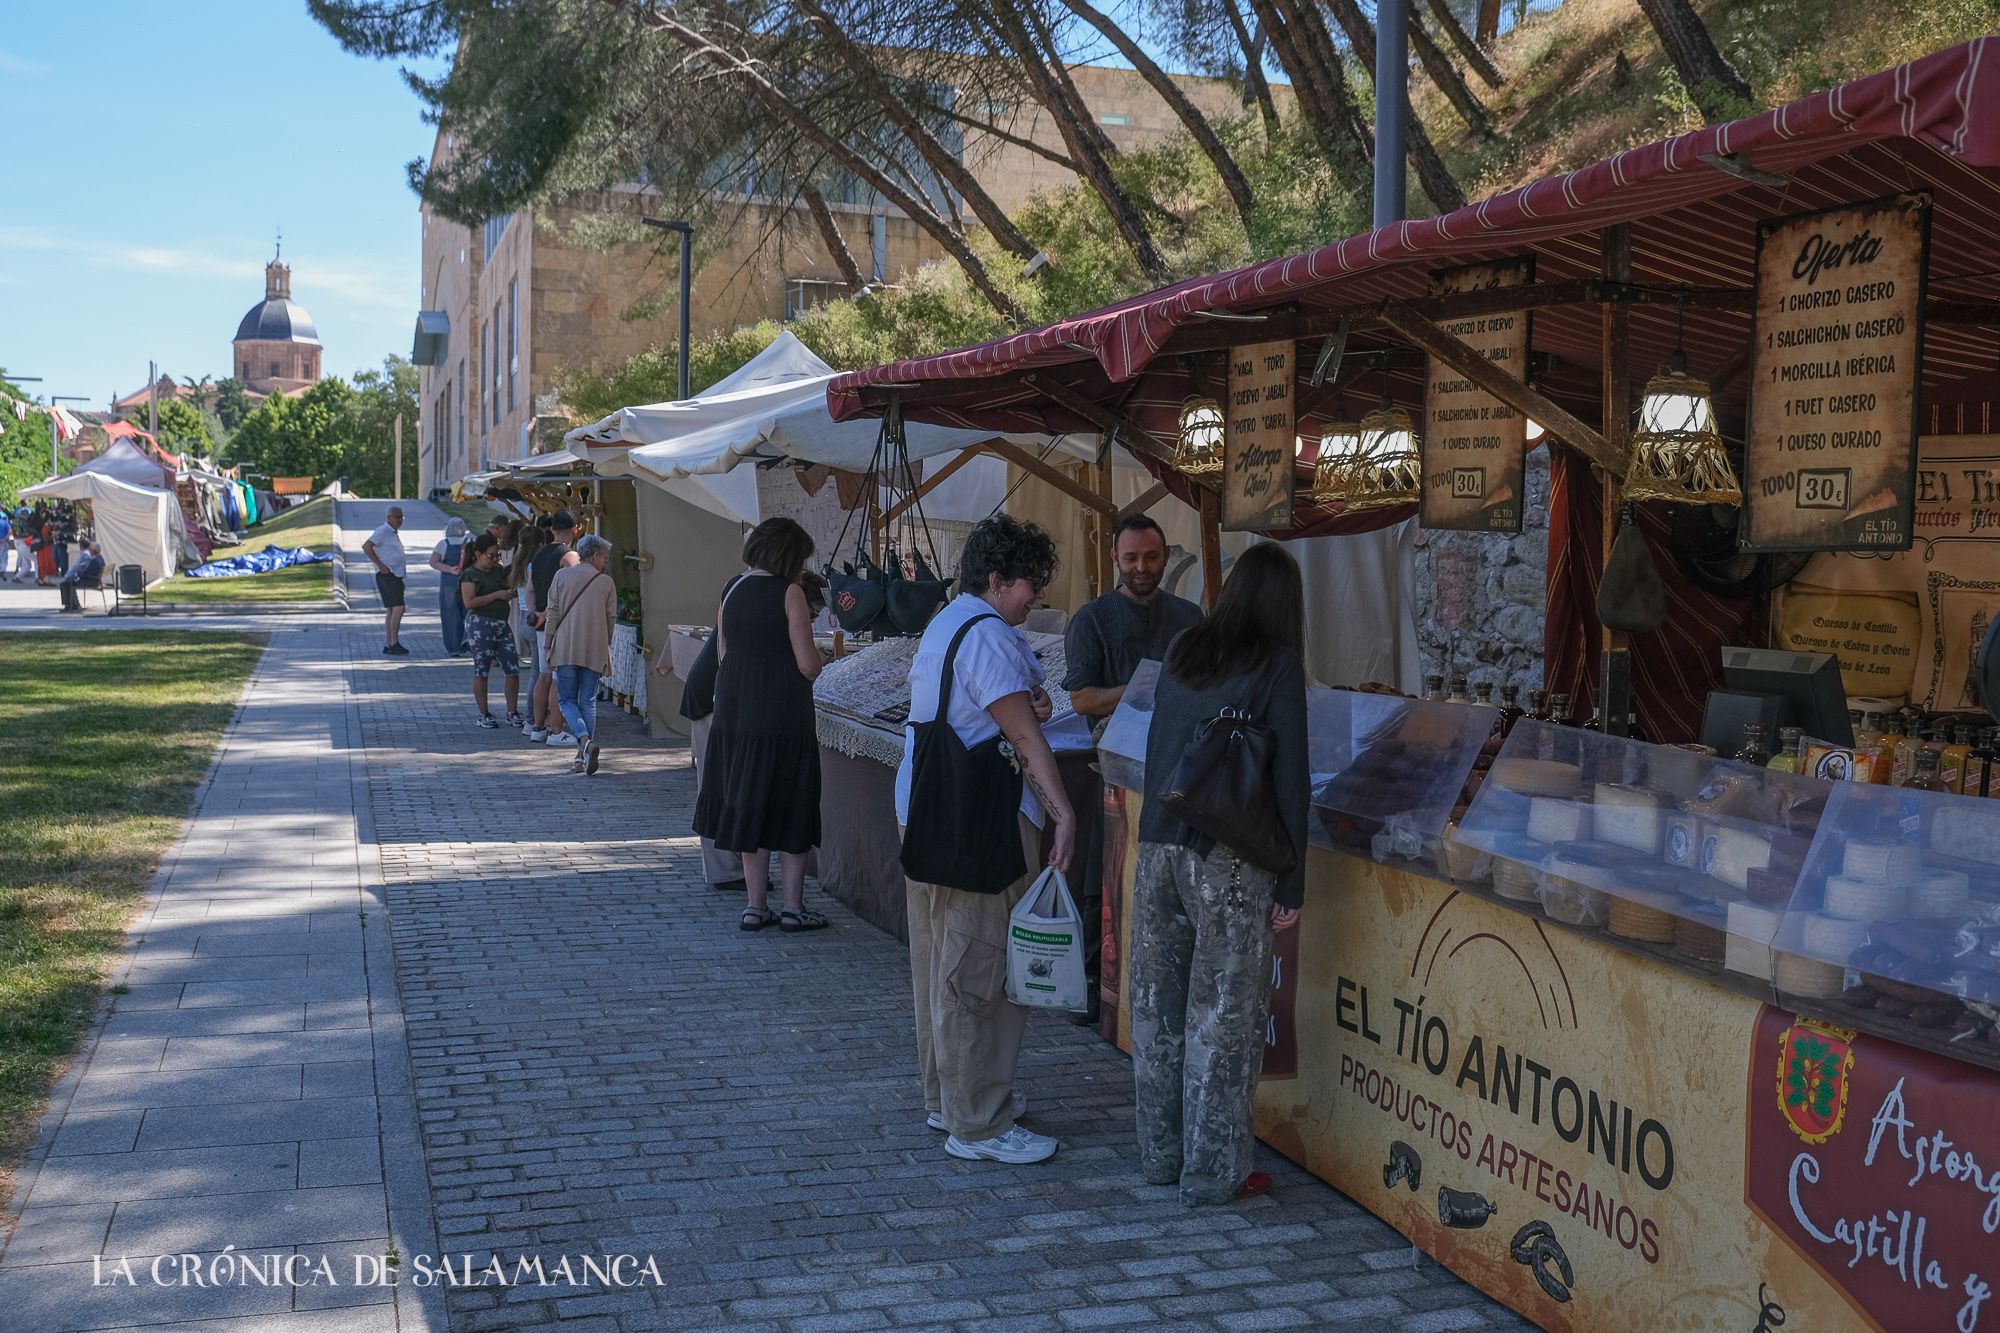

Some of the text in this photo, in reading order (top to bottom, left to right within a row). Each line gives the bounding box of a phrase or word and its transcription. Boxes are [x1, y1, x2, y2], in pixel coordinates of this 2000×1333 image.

[1792, 229, 1885, 285] Oferta
[1778, 281, 1895, 313] 1 CHORIZO CASERO
[1477, 320, 1486, 333] DE
[1488, 316, 1514, 332] CIERVO
[1767, 316, 1905, 349] 1 SALCHICHÓN CASERO
[1488, 343, 1512, 361] JABALÍ
[1770, 352, 1896, 383] 1 MORCILLA IBÉRICA
[1432, 383, 1437, 395] 1
[1432, 410, 1437, 422] 1
[1437, 405, 1478, 423] SALCHICHÓN
[1480, 407, 1489, 421] DE
[1784, 393, 1876, 417] 1 FUET CASERO
[1442, 436, 1501, 450] 1 QUESO CURADO
[1777, 429, 1882, 452] 1 QUESO CURADO
[1235, 442, 1282, 473] Astorga
[1431, 470, 1453, 489] TODO
[1760, 472, 1796, 498] TODO
[1917, 470, 1952, 503] El
[1865, 518, 1897, 531] EL TÍO
[1858, 532, 1903, 545] ANTONIO
[1812, 616, 1898, 634] Quesos de Castilla
[1790, 633, 1828, 648] Quesos
[1830, 638, 1840, 649] de
[1872, 645, 1879, 655] y
[1855, 662, 1865, 672] de
[1867, 662, 1891, 675] León
[1334, 975, 1381, 1045] EL
[1393, 994, 1449, 1076] TÍO
[1455, 1035, 1675, 1191] ANTONIO
[1339, 1053, 1660, 1264] PRODUCTOS ARTESANOS
[1864, 1076, 2000, 1233] Astorg
[1788, 1152, 1992, 1333] Castilla y
